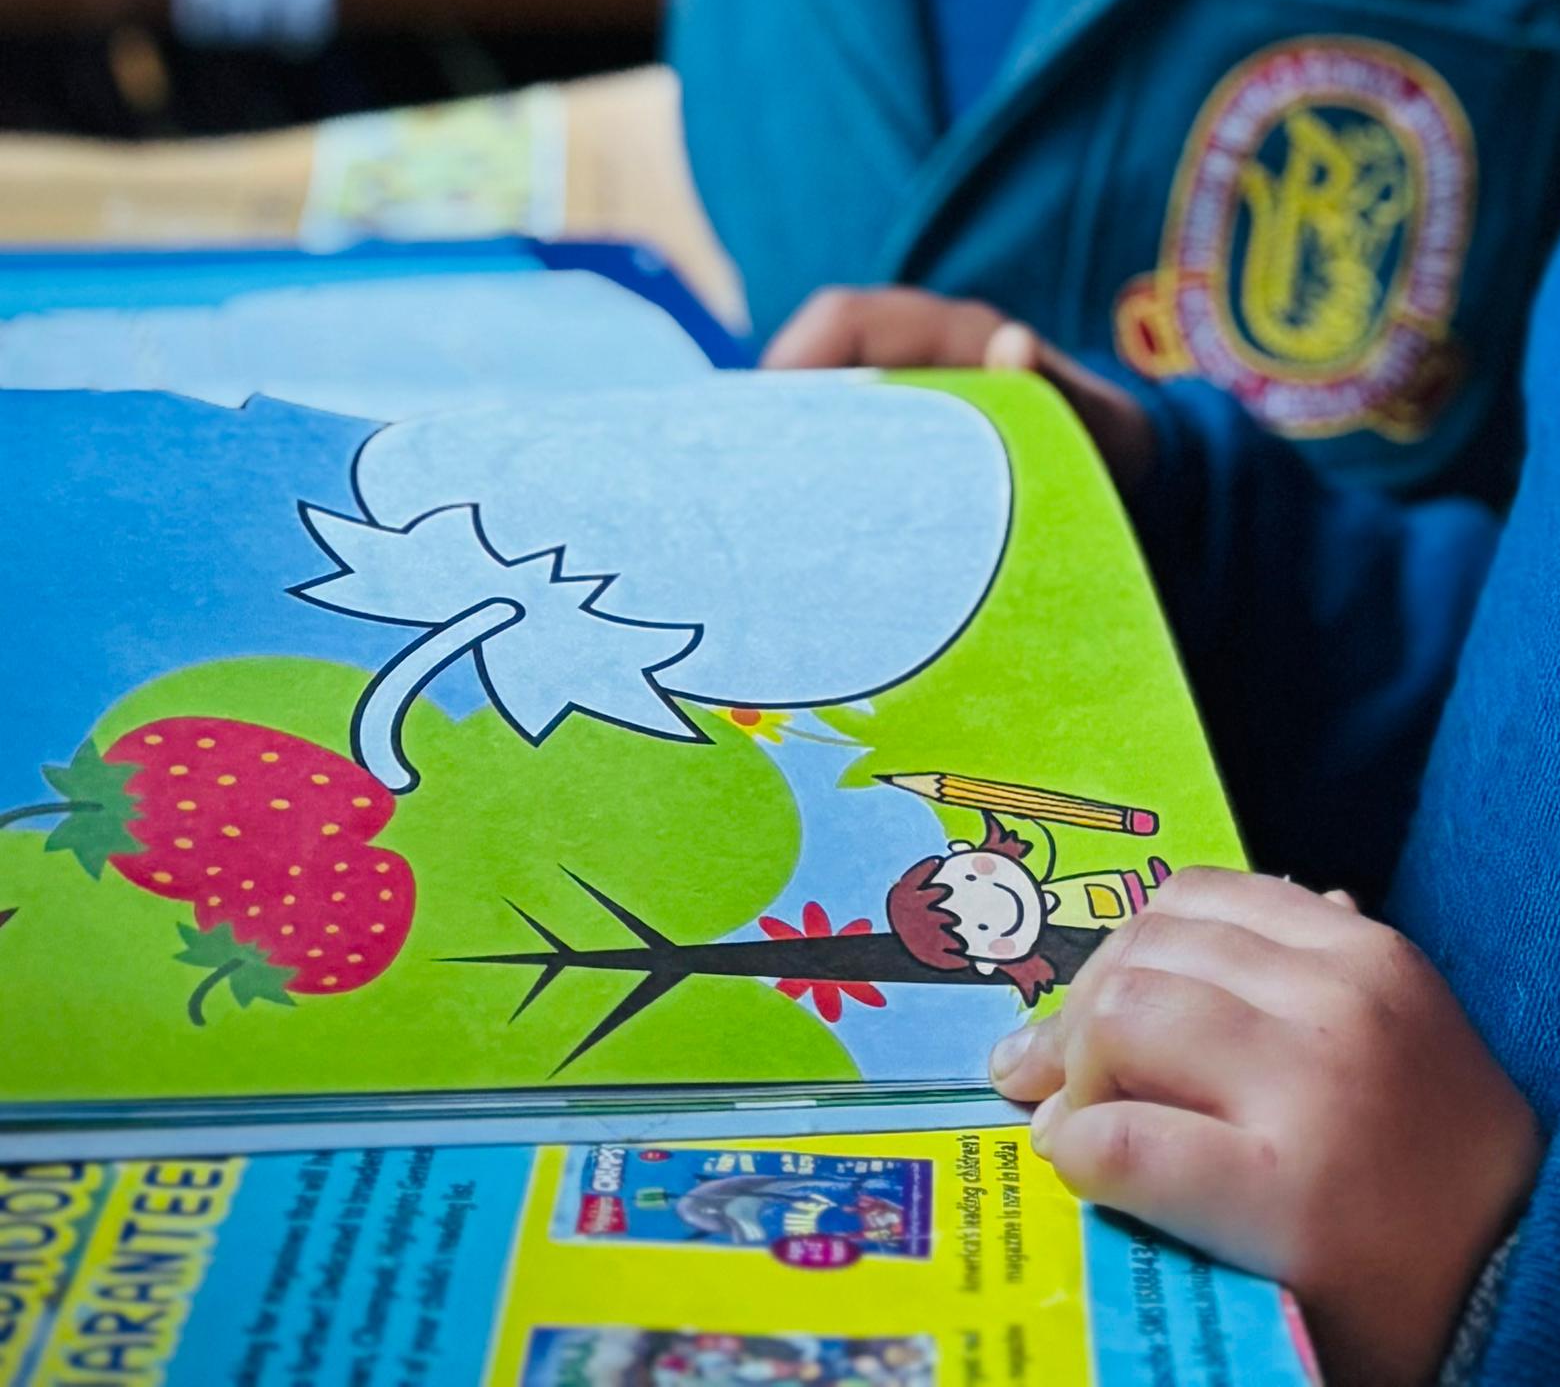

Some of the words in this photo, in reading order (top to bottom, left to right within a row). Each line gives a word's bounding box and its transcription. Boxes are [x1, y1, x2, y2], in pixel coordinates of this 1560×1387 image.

[956, 1135, 980, 1182] children's
[996, 1172, 1020, 1182] in
[956, 1187, 988, 1230] leading
[1003, 1184, 1020, 1208] now
[996, 1211, 1021, 1219] is
[996, 1222, 1030, 1284] magazine
